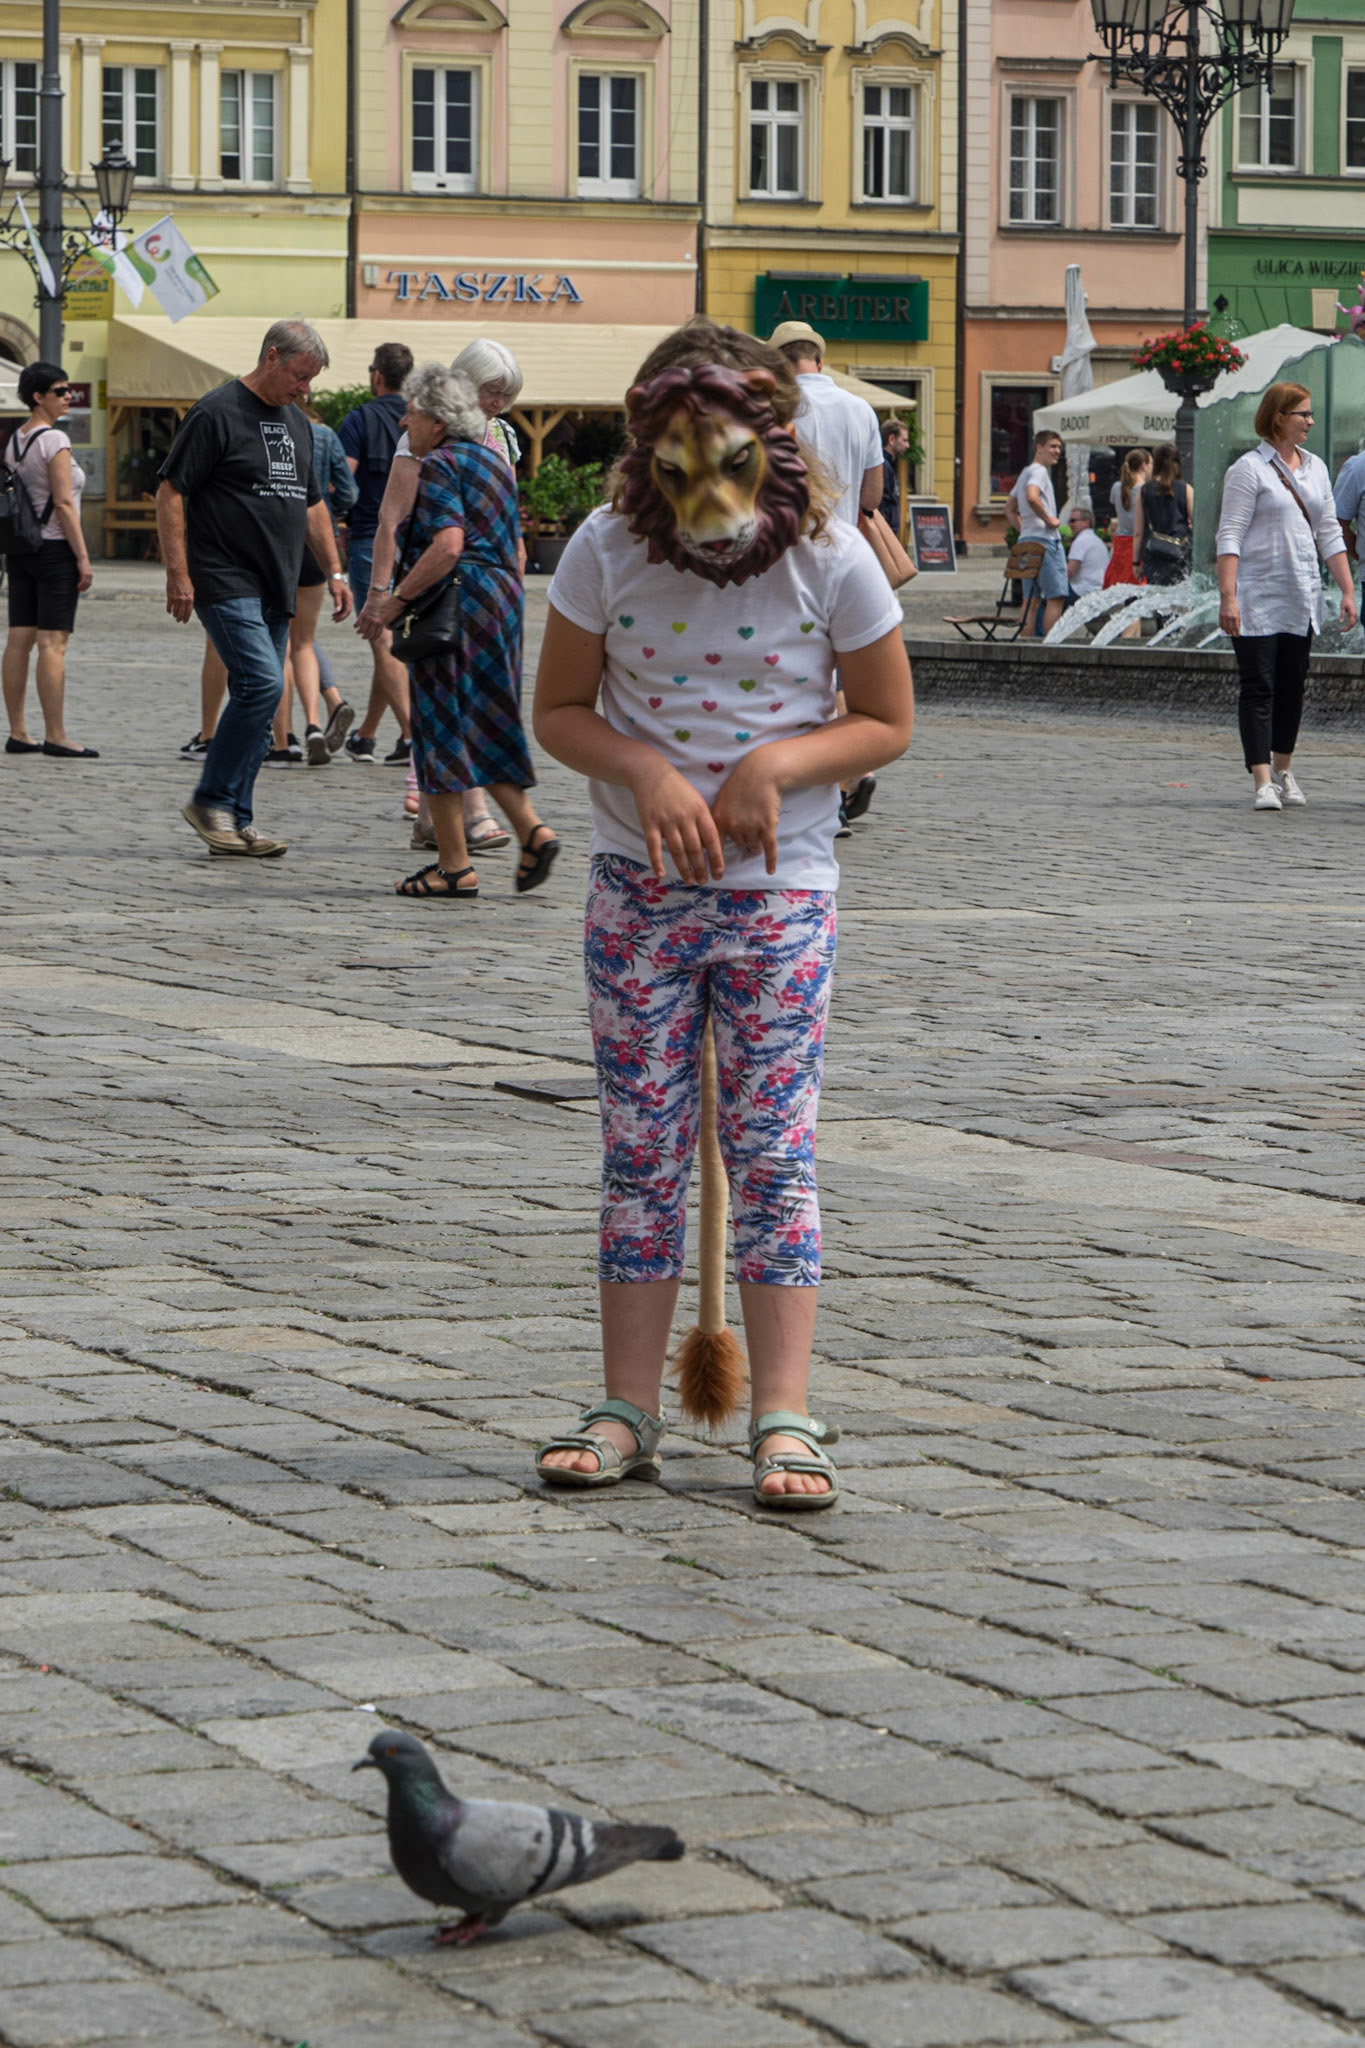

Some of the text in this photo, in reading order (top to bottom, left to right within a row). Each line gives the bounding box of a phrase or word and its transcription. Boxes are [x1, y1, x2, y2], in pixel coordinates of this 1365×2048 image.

[1256, 258, 1304, 275] ULICA
[386, 271, 583, 303] TASZKA
[774, 292, 912, 323] ARBITER
[263, 426, 286, 434] BLACK
[1060, 415, 1090, 431] BADOIT
[1143, 415, 1177, 432] BADOIT
[271, 461, 294, 471] SHEEP
